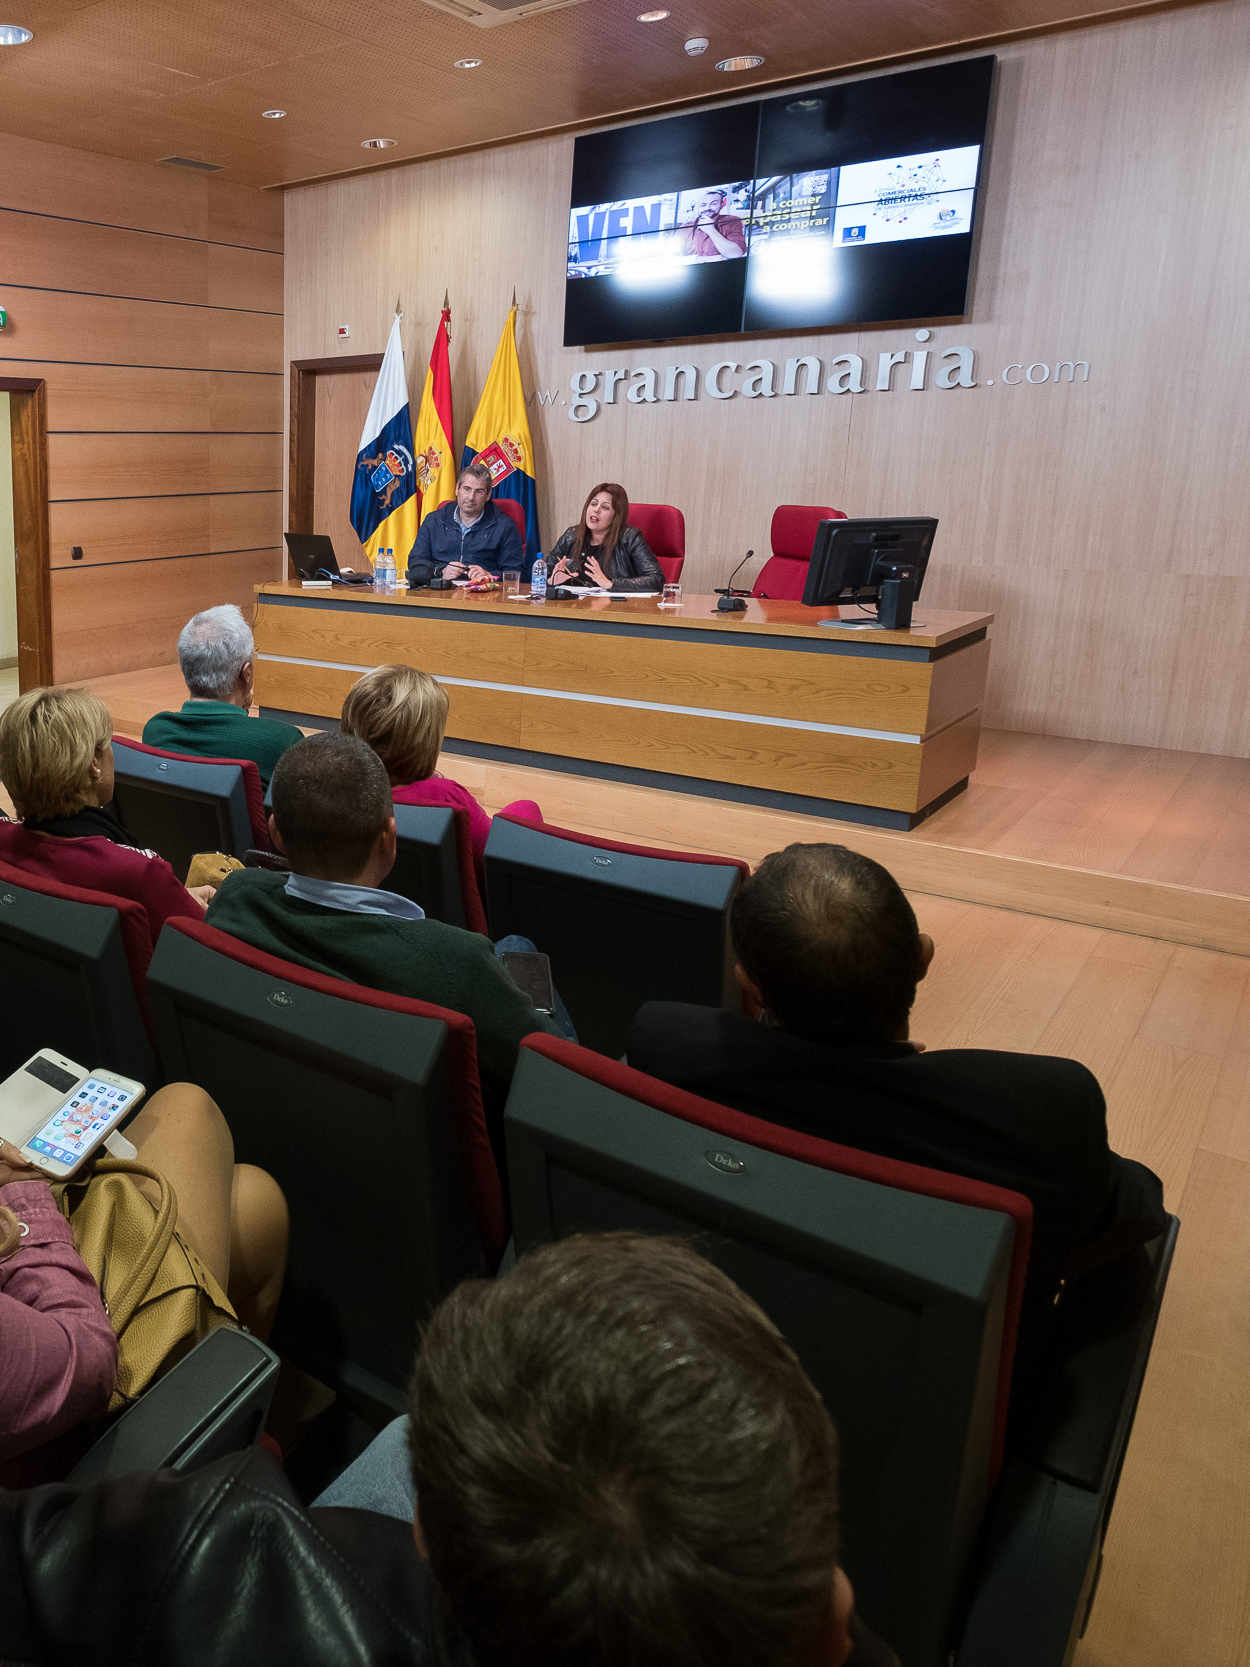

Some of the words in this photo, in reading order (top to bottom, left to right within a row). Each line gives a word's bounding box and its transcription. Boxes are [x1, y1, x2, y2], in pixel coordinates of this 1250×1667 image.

[876, 192, 926, 206] ABIERTAS
[878, 187, 927, 197] COMERCIALES
[769, 202, 777, 210] a
[779, 196, 822, 208] comer
[576, 203, 662, 262] VEN
[762, 225, 770, 233] a
[772, 217, 829, 231] comprar
[714, 1153, 739, 1169] Deko
